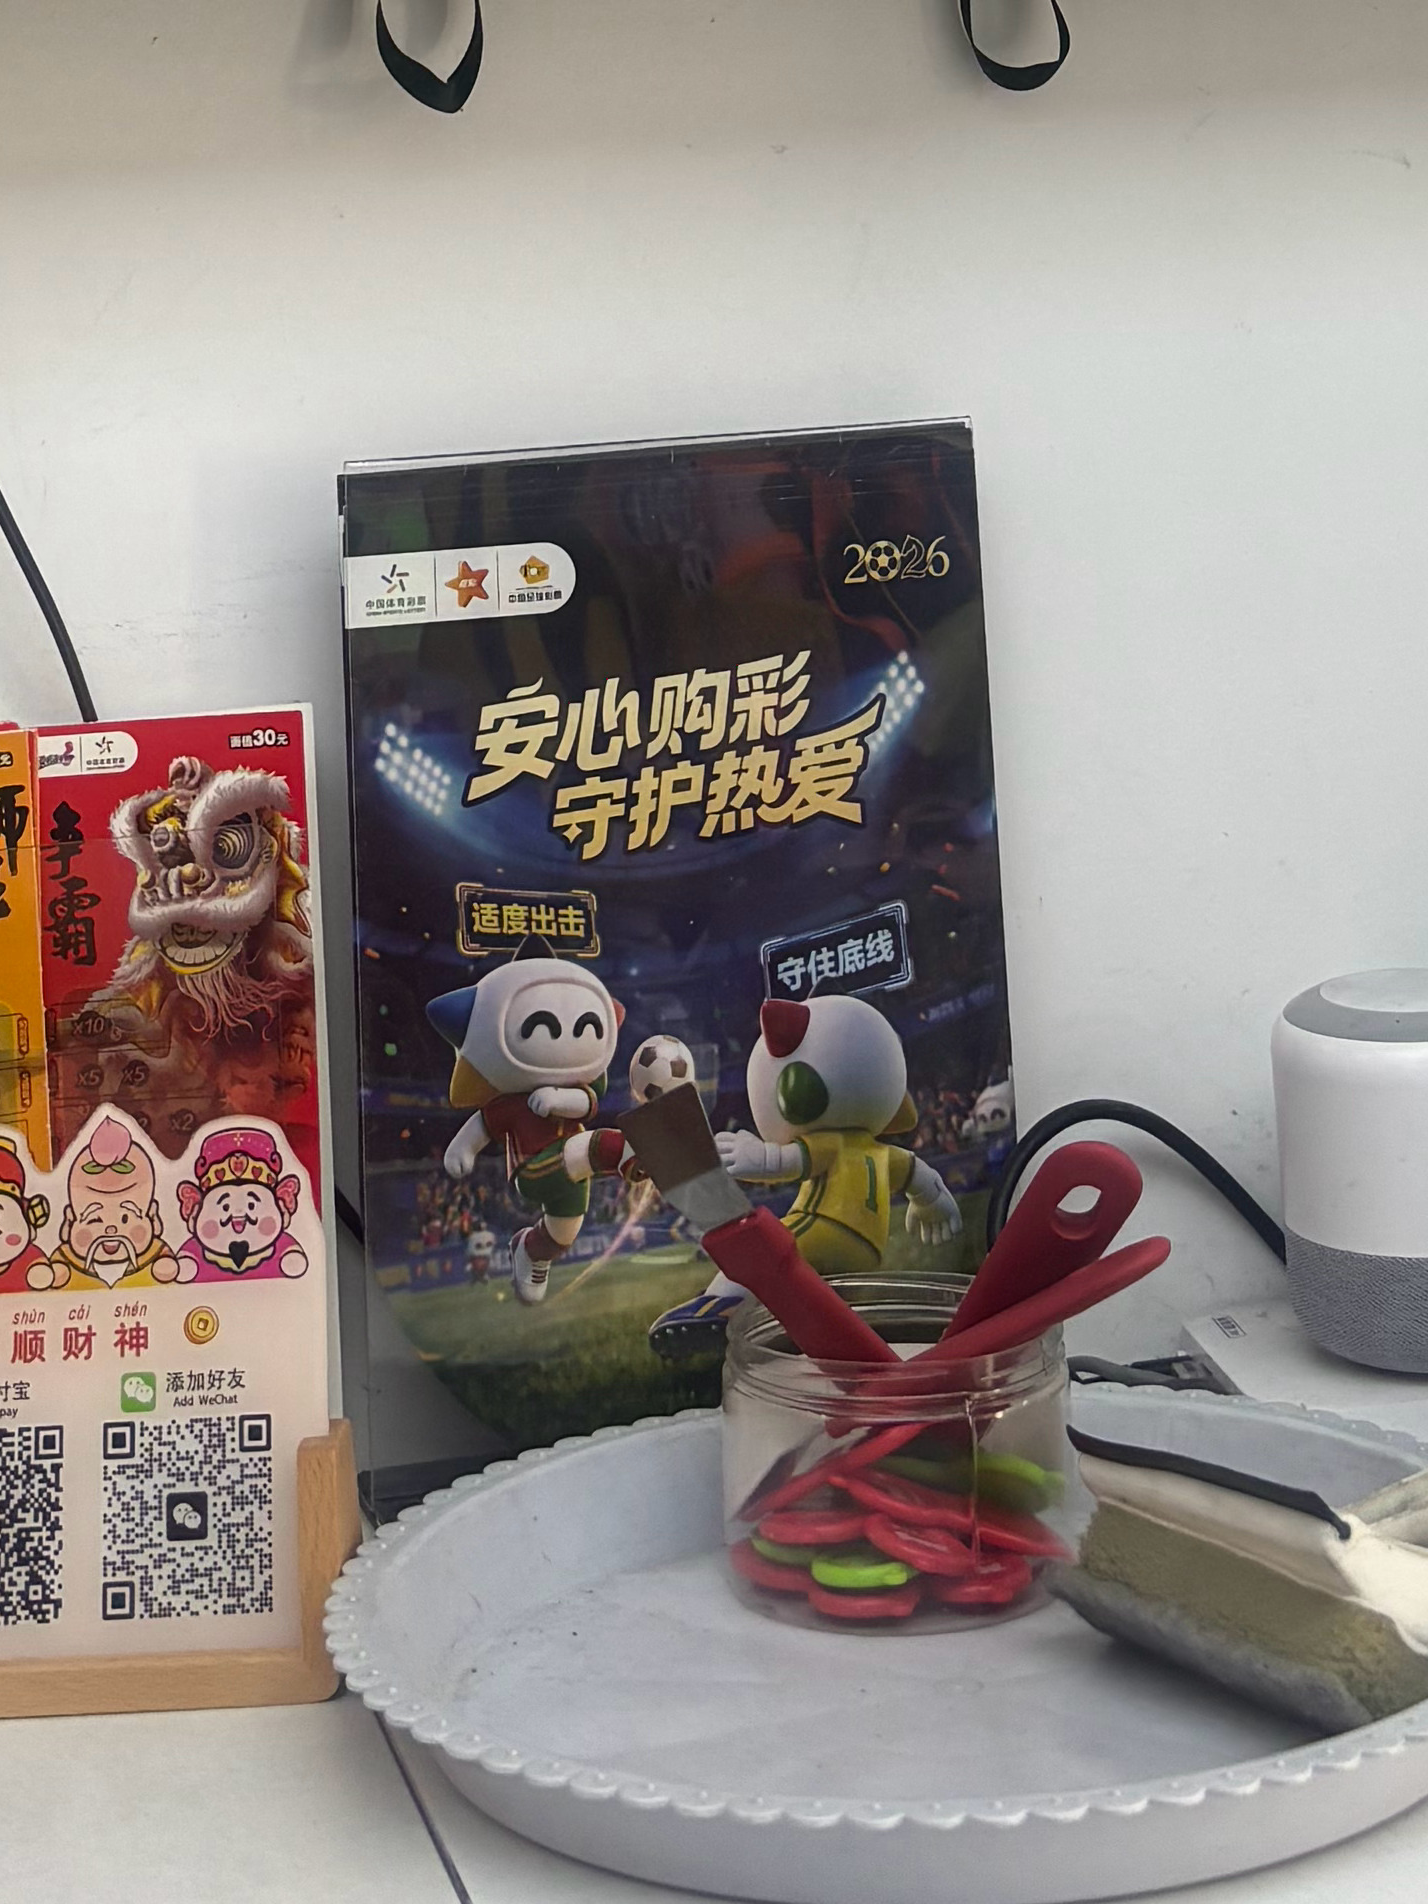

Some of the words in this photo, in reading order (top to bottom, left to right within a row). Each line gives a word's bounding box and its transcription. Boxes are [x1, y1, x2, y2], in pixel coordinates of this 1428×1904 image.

[365, 596, 426, 610] 中国体育彩票
[508, 589, 562, 604] 中国足球彩票
[229, 728, 288, 748] 面值30元
[465, 651, 811, 805] 安心购彩
[552, 694, 886, 860] 守护热爱
[44, 800, 100, 966] 争霸
[472, 901, 586, 934] 适度出击
[777, 929, 894, 990] 守住底线
[12, 1306, 45, 1325] shùn
[166, 1369, 246, 1393] 添加好友
[173, 1395, 194, 1407] Add
[199, 1392, 238, 1406] WeChat
